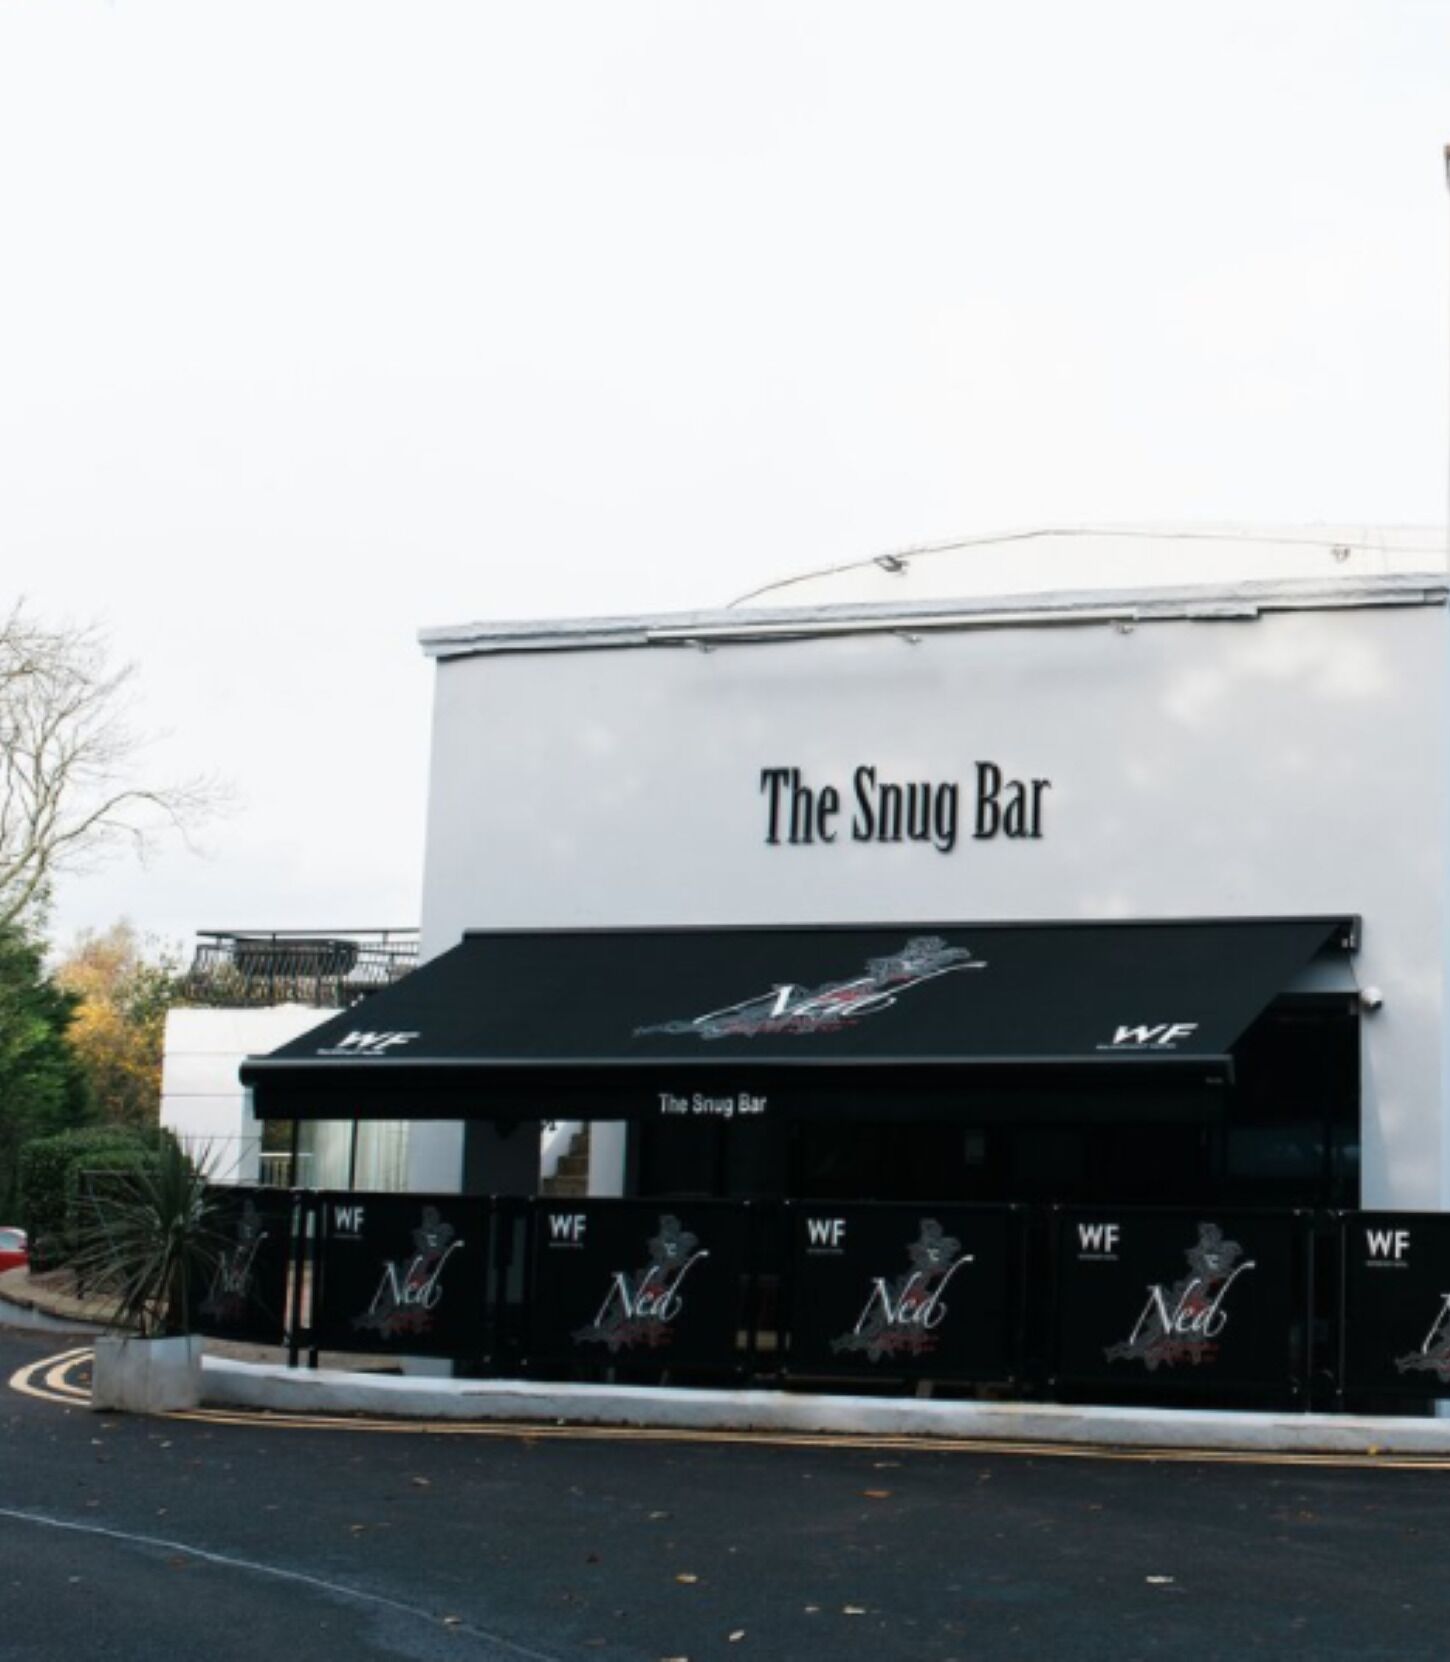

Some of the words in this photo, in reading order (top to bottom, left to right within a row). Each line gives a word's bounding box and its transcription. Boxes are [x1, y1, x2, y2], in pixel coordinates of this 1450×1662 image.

[760, 768, 837, 845] The
[851, 766, 959, 854] Snug
[972, 761, 1051, 840] Bar
[335, 1031, 421, 1051] WF
[1112, 1022, 1199, 1044] WF
[659, 1093, 688, 1113] The
[692, 1094, 733, 1117] Snug
[738, 1094, 767, 1113] Bar
[334, 1206, 365, 1233] WF
[550, 1215, 586, 1242] WF
[807, 1219, 846, 1246] WF
[1078, 1223, 1120, 1252] WF
[1366, 1229, 1410, 1258] WF
[369, 1239, 465, 1314] Ned
[594, 1250, 709, 1328] Ned
[853, 1254, 974, 1335] Ned
[1129, 1260, 1256, 1345] Ned
